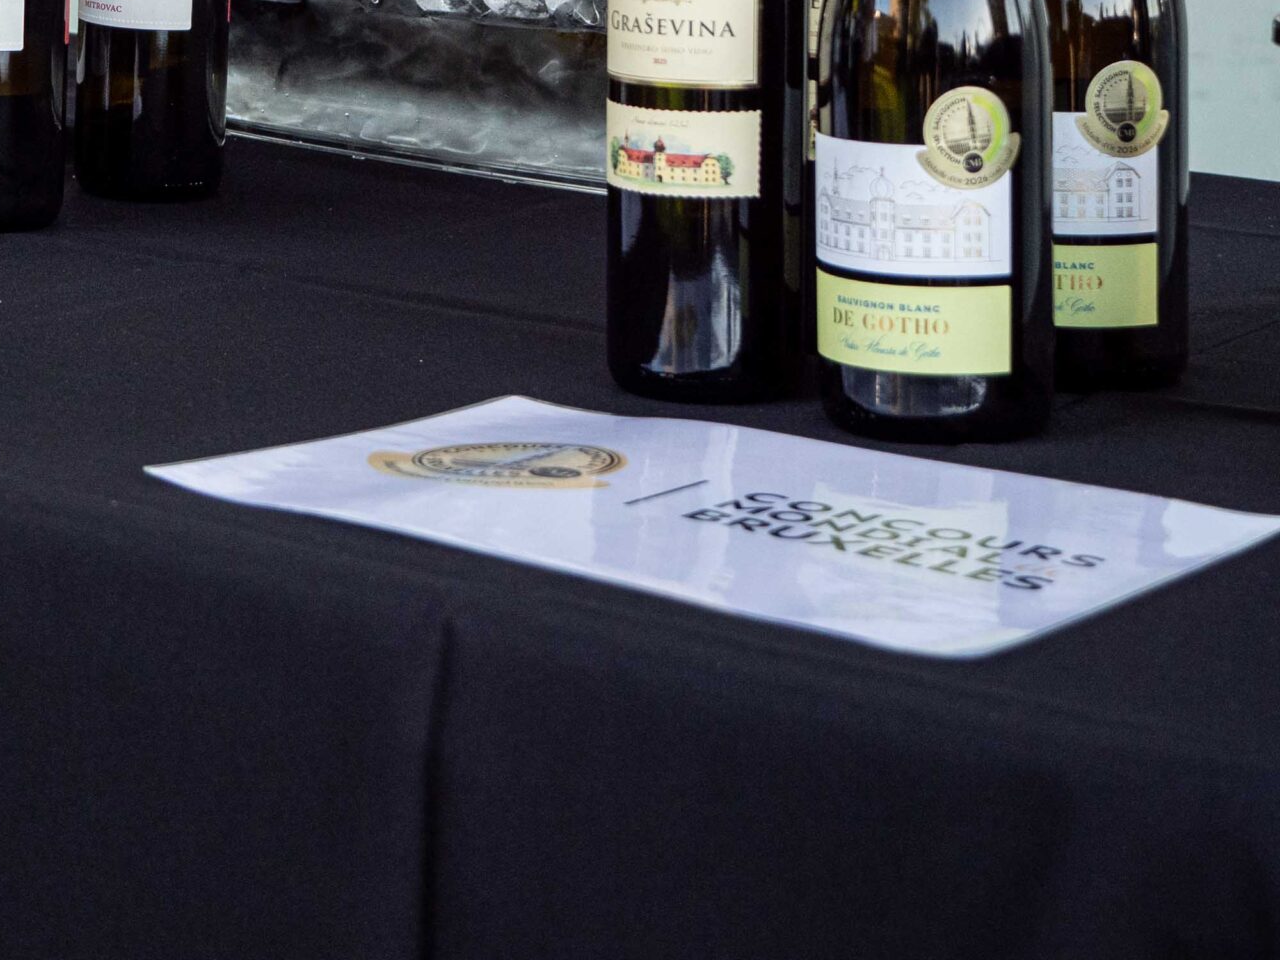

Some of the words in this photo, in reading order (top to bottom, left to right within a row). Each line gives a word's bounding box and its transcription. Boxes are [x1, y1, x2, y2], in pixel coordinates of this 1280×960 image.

[84, 0, 122, 13] MITROVAC
[611, 10, 736, 38] GRAŠEVINA
[1094, 70, 1129, 98] SAUVIGNON
[932, 97, 966, 130] SAUVIGNON
[933, 134, 961, 165] SELECTION
[1055, 261, 1095, 270] BLANC
[837, 295, 894, 311] SAUVIGNON
[899, 303, 941, 313] BLANC
[832, 306, 854, 327] DE
[862, 312, 950, 335] GOTHO
[715, 499, 1002, 565] MONDIAL
[744, 492, 1106, 569] CONCOURS
[682, 509, 1054, 590] BRUXELLES
